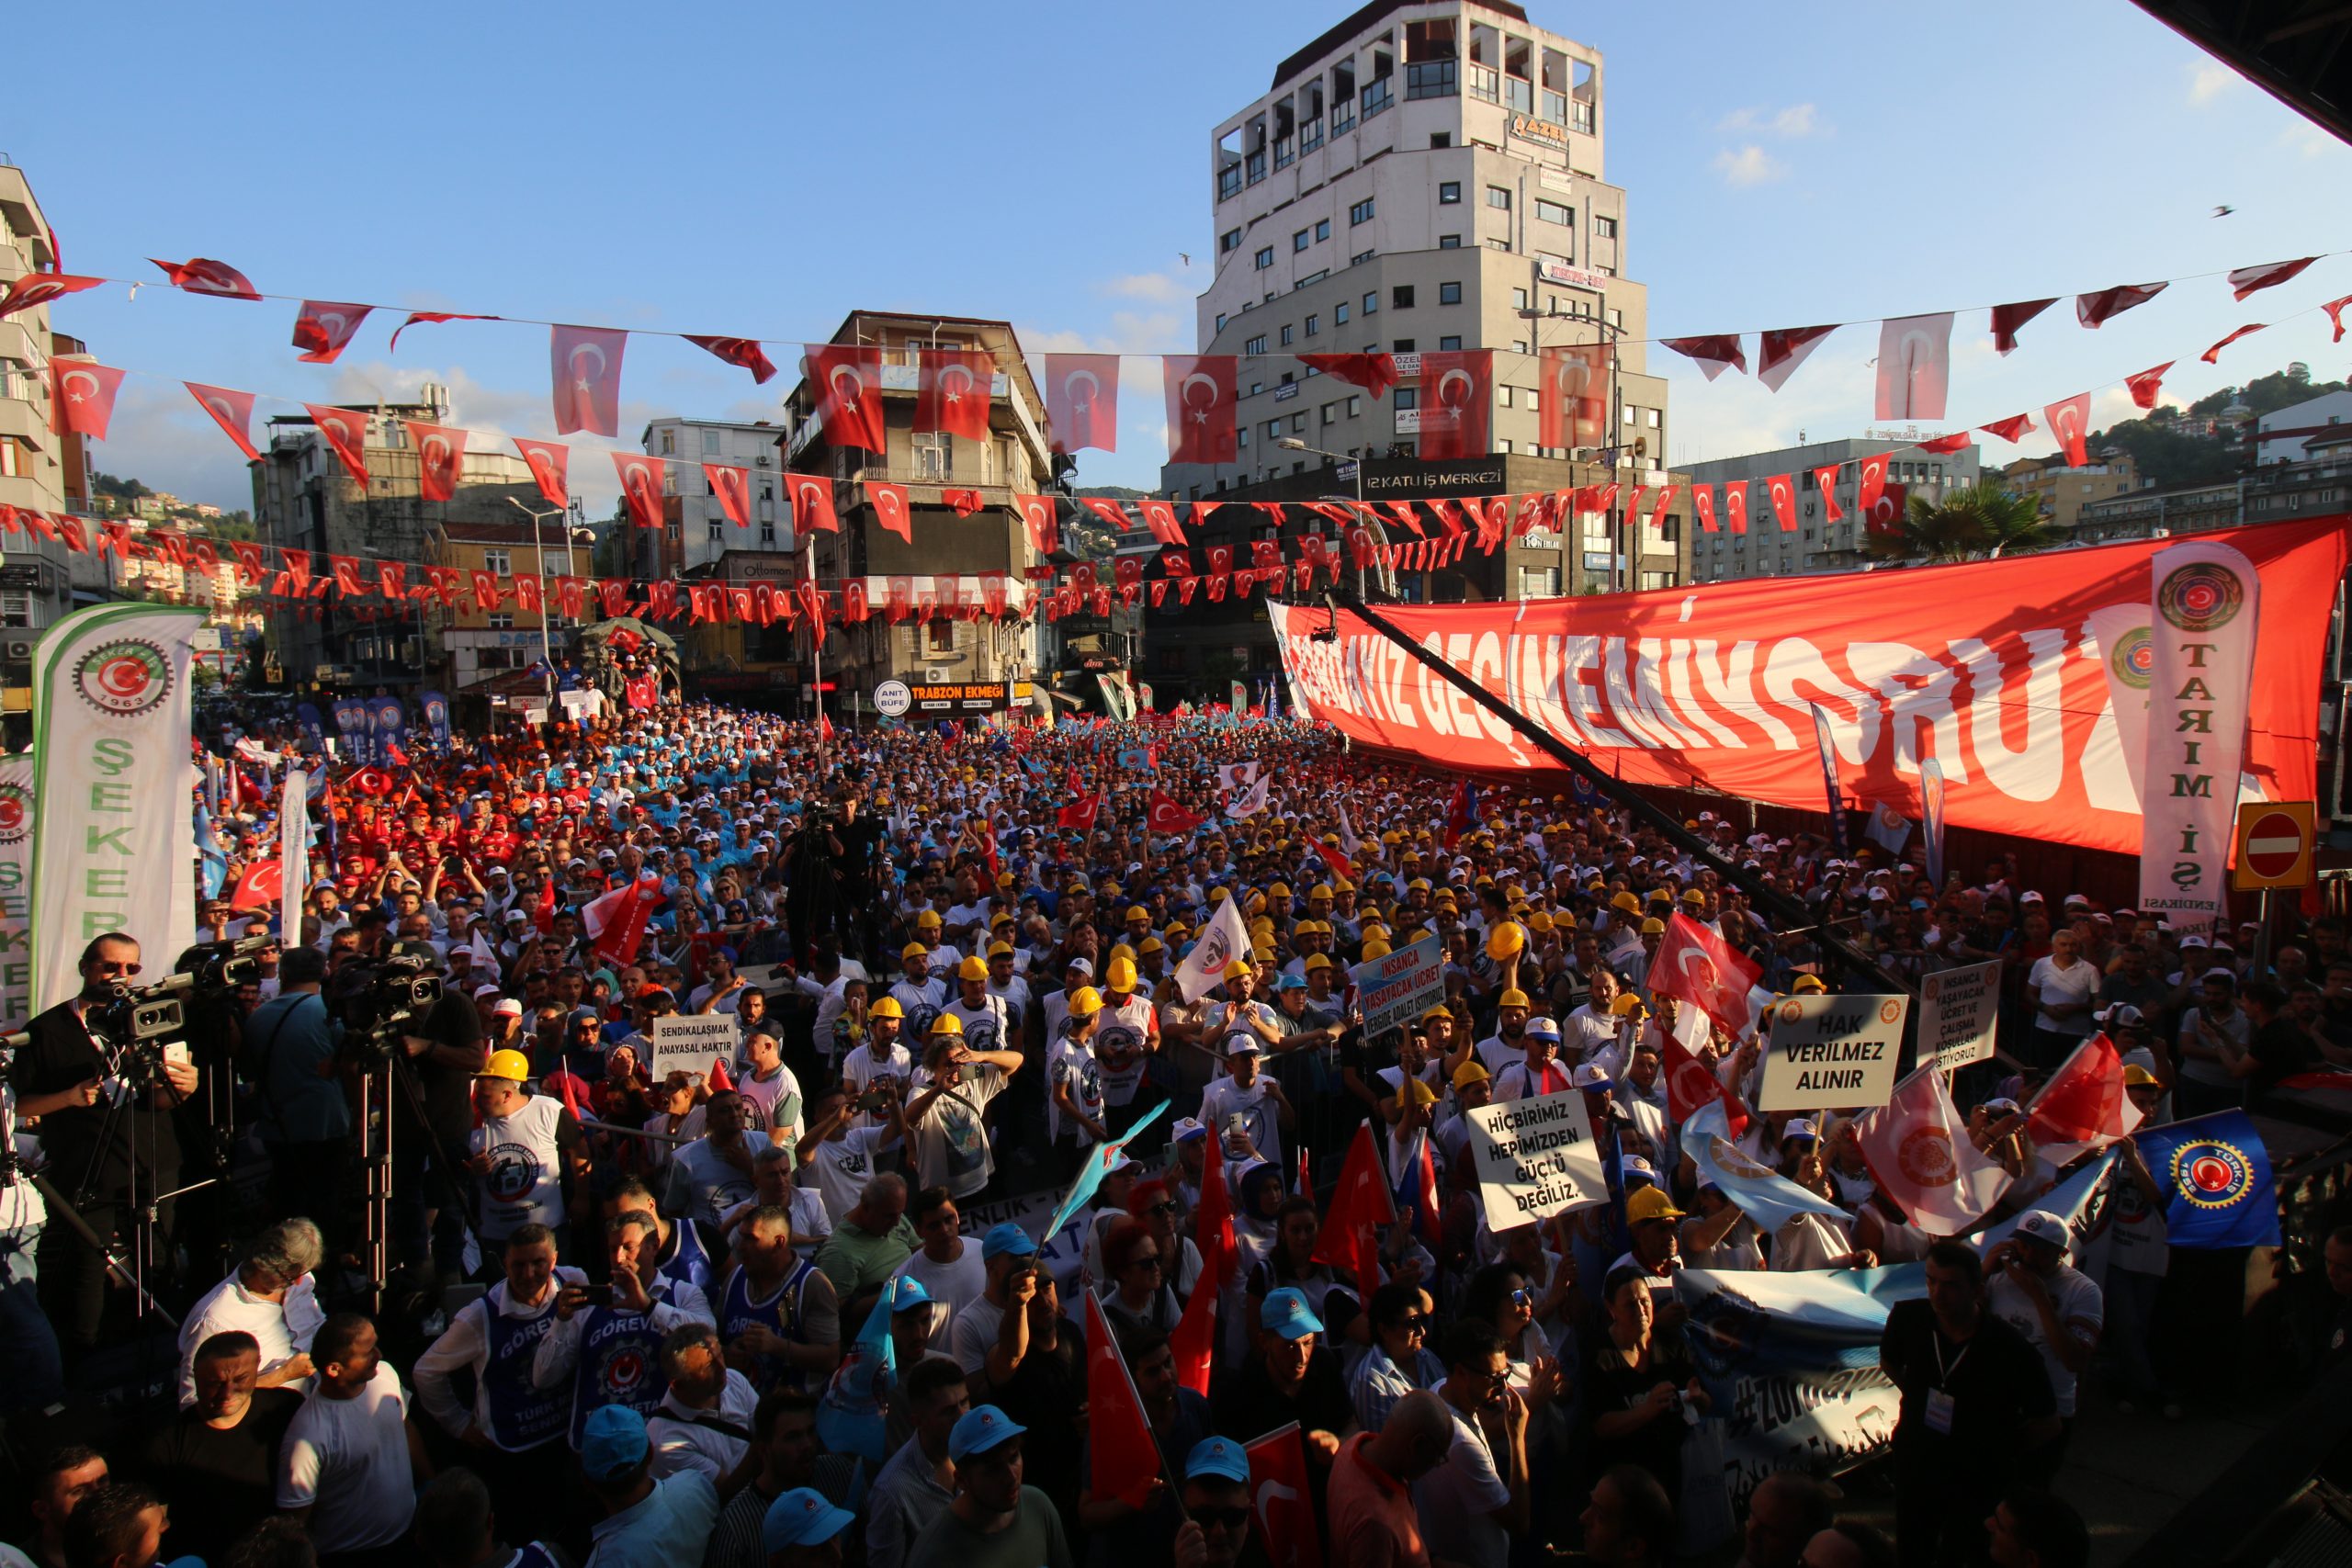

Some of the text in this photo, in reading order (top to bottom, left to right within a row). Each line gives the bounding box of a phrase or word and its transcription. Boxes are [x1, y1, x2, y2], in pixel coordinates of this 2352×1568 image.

[1526, 118, 1567, 142] AZEL
[1424, 472, 1437, 490] İŞ
[1440, 468, 1501, 485] MERKEZİ
[744, 561, 791, 578] Ottoman
[100, 694, 143, 707] 1963
[881, 698, 905, 707] BÜFE
[911, 687, 962, 699] TRABZON
[966, 684, 1003, 698] EKMEĞİ
[83, 738, 135, 941] ŞEKER
[1381, 949, 1419, 978] İNSANCA
[1415, 964, 1440, 988] ÜCRET
[1393, 998, 1414, 1022] ADALET
[1968, 1001, 1978, 1013] VE
[662, 1024, 729, 1037] SENDİKALAŞMAK
[1817, 1015, 1863, 1034] HAK
[1940, 1018, 1975, 1039] ÇALIŞMA
[658, 1042, 732, 1055] ANAYASAL HAKTIR
[1786, 1037, 1885, 1063] VERİLMEZ
[1935, 1032, 1978, 1053] KOŞULLARI
[1795, 1069, 1864, 1090] ALINIR
[1487, 1100, 1569, 1134] HİÇBİRİMİZ
[1488, 1127, 1579, 1161] HEPİMİZDEN
[1515, 1152, 1566, 1183] GÜÇLÜ
[2180, 1162, 2197, 1193] 1952
[1516, 1180, 1578, 1212] DEĞİLİZ.
